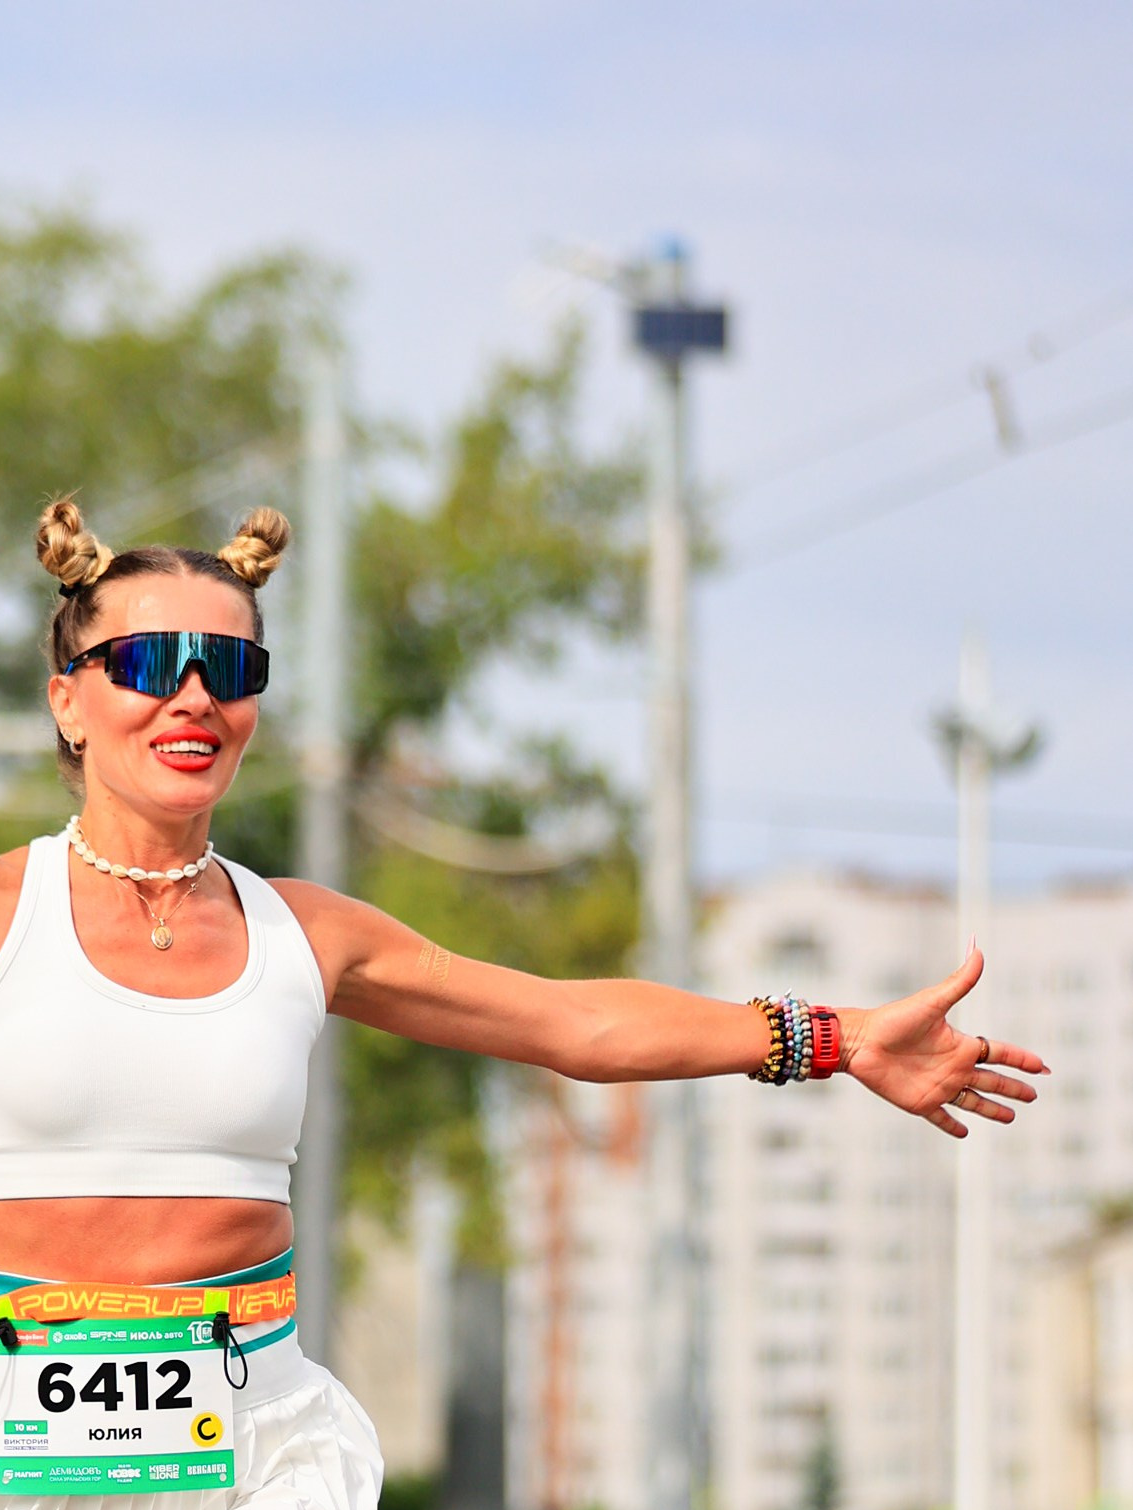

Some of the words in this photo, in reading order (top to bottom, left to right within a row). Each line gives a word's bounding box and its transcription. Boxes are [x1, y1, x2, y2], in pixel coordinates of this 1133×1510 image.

[18, 1291, 203, 1317] POWERUP
[130, 1331, 163, 1340] ИЮЛЬ
[38, 1359, 192, 1413] 6412
[15, 1424, 25, 1432] 10
[88, 1428, 142, 1441] ЮЛИЯ
[49, 1467, 102, 1476] ДЕМИДОВЪ
